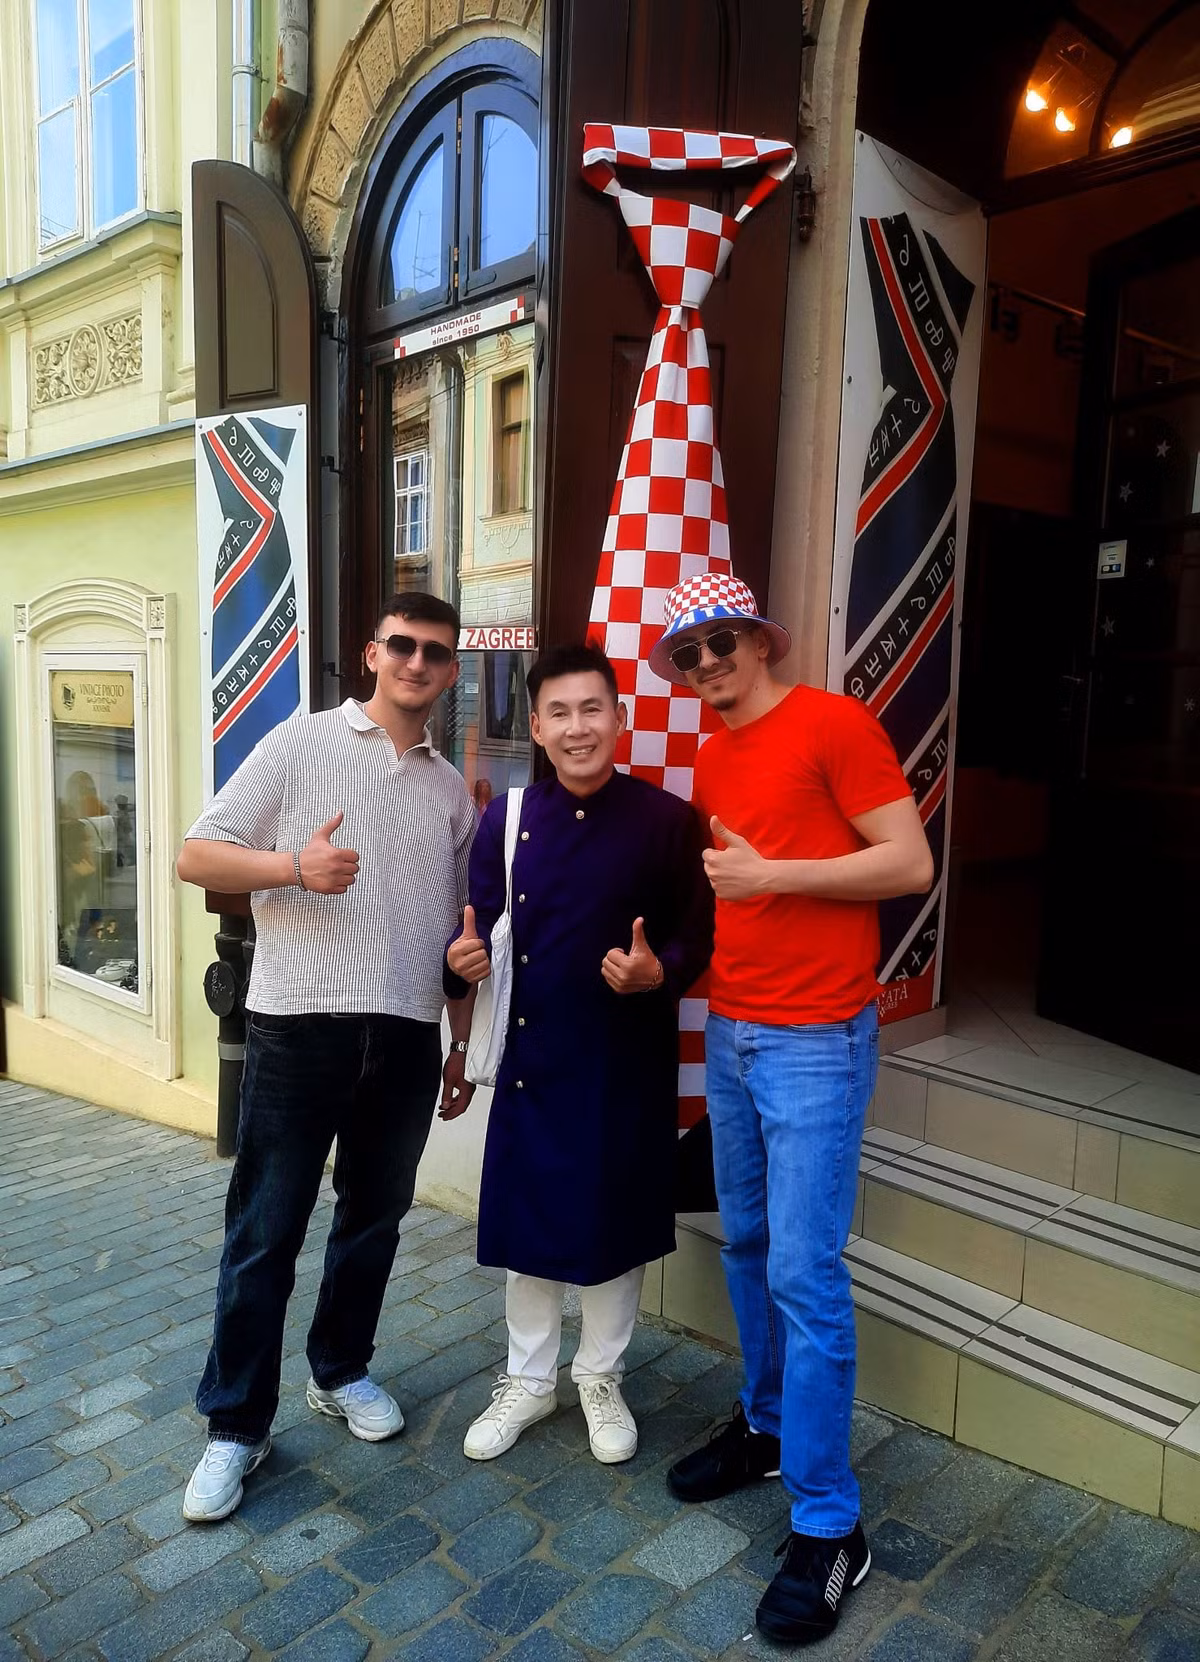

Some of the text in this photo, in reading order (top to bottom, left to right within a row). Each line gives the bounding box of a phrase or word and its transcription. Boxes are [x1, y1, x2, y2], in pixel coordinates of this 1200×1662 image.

[430, 312, 482, 335] HANDMADE
[432, 324, 480, 346] since 1950
[825, 1549, 849, 1611] PUMA
